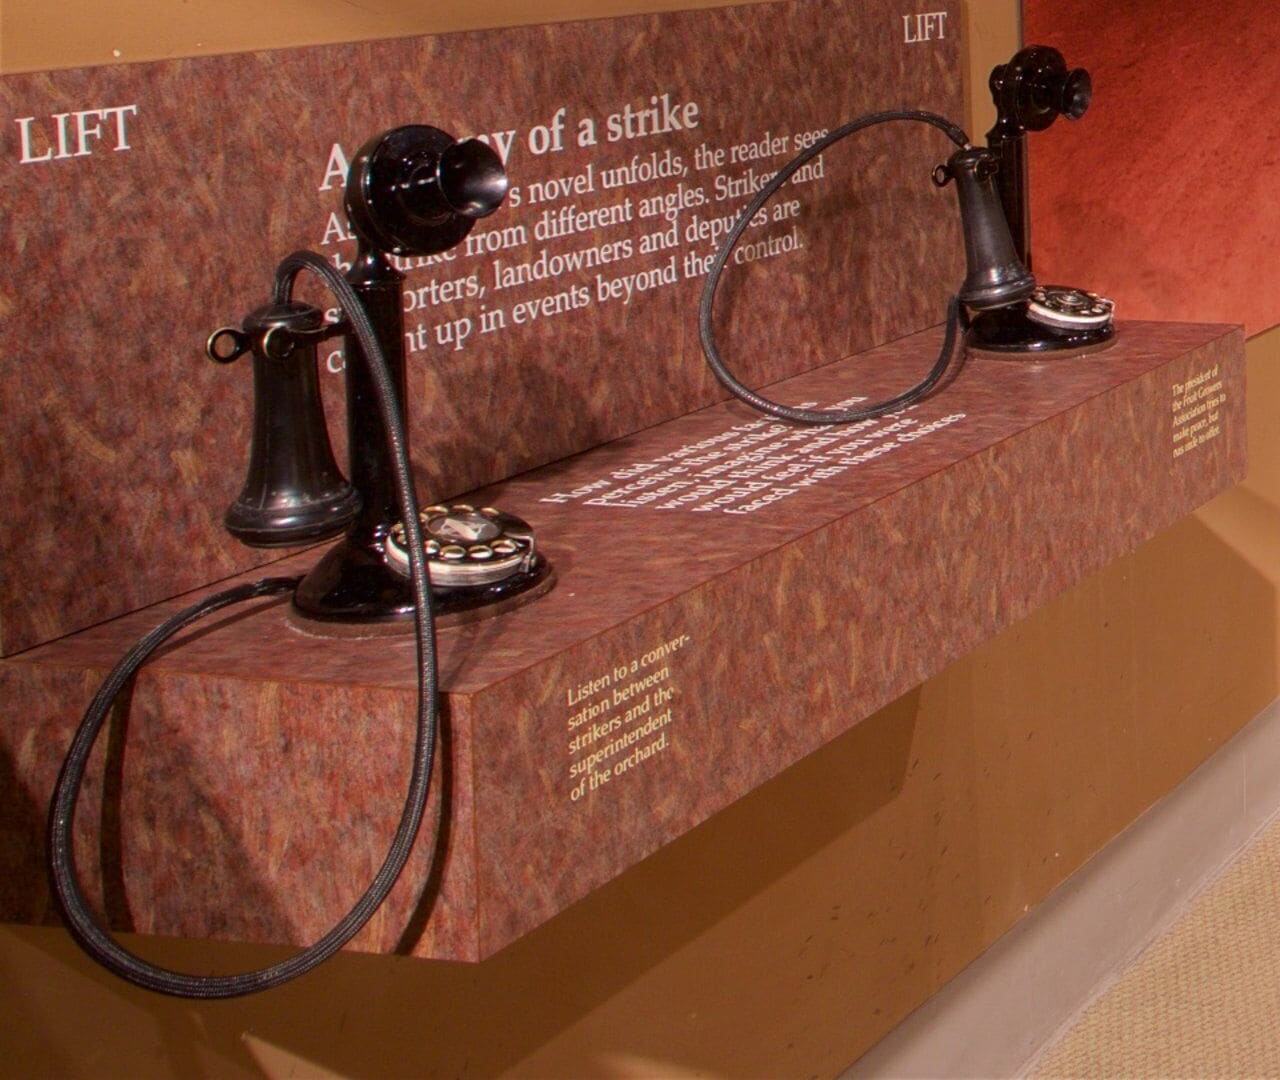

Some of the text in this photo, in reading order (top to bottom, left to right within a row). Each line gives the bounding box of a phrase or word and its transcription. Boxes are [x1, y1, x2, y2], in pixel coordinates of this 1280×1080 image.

[902, 11, 947, 44] LIFT
[14, 104, 137, 164] LIFT
[528, 93, 699, 155] of a strike
[527, 131, 790, 204] novel unfolds, the reader
[464, 183, 710, 257] from different angles.
[492, 239, 634, 291] landowners
[639, 219, 680, 255] and
[773, 200, 801, 222] are
[434, 225, 804, 352] up in events beyond control.
[539, 463, 658, 502] How did
[688, 442, 787, 477] imagine
[723, 442, 900, 514] faced with these
[728, 454, 797, 477] think
[761, 418, 917, 480] feel you were
[567, 666, 671, 732] sation between
[568, 634, 691, 707] Listen conver-
[568, 686, 676, 756] strikers and the
[569, 708, 673, 780] superintendent
[570, 731, 670, 802] of the orchard.
